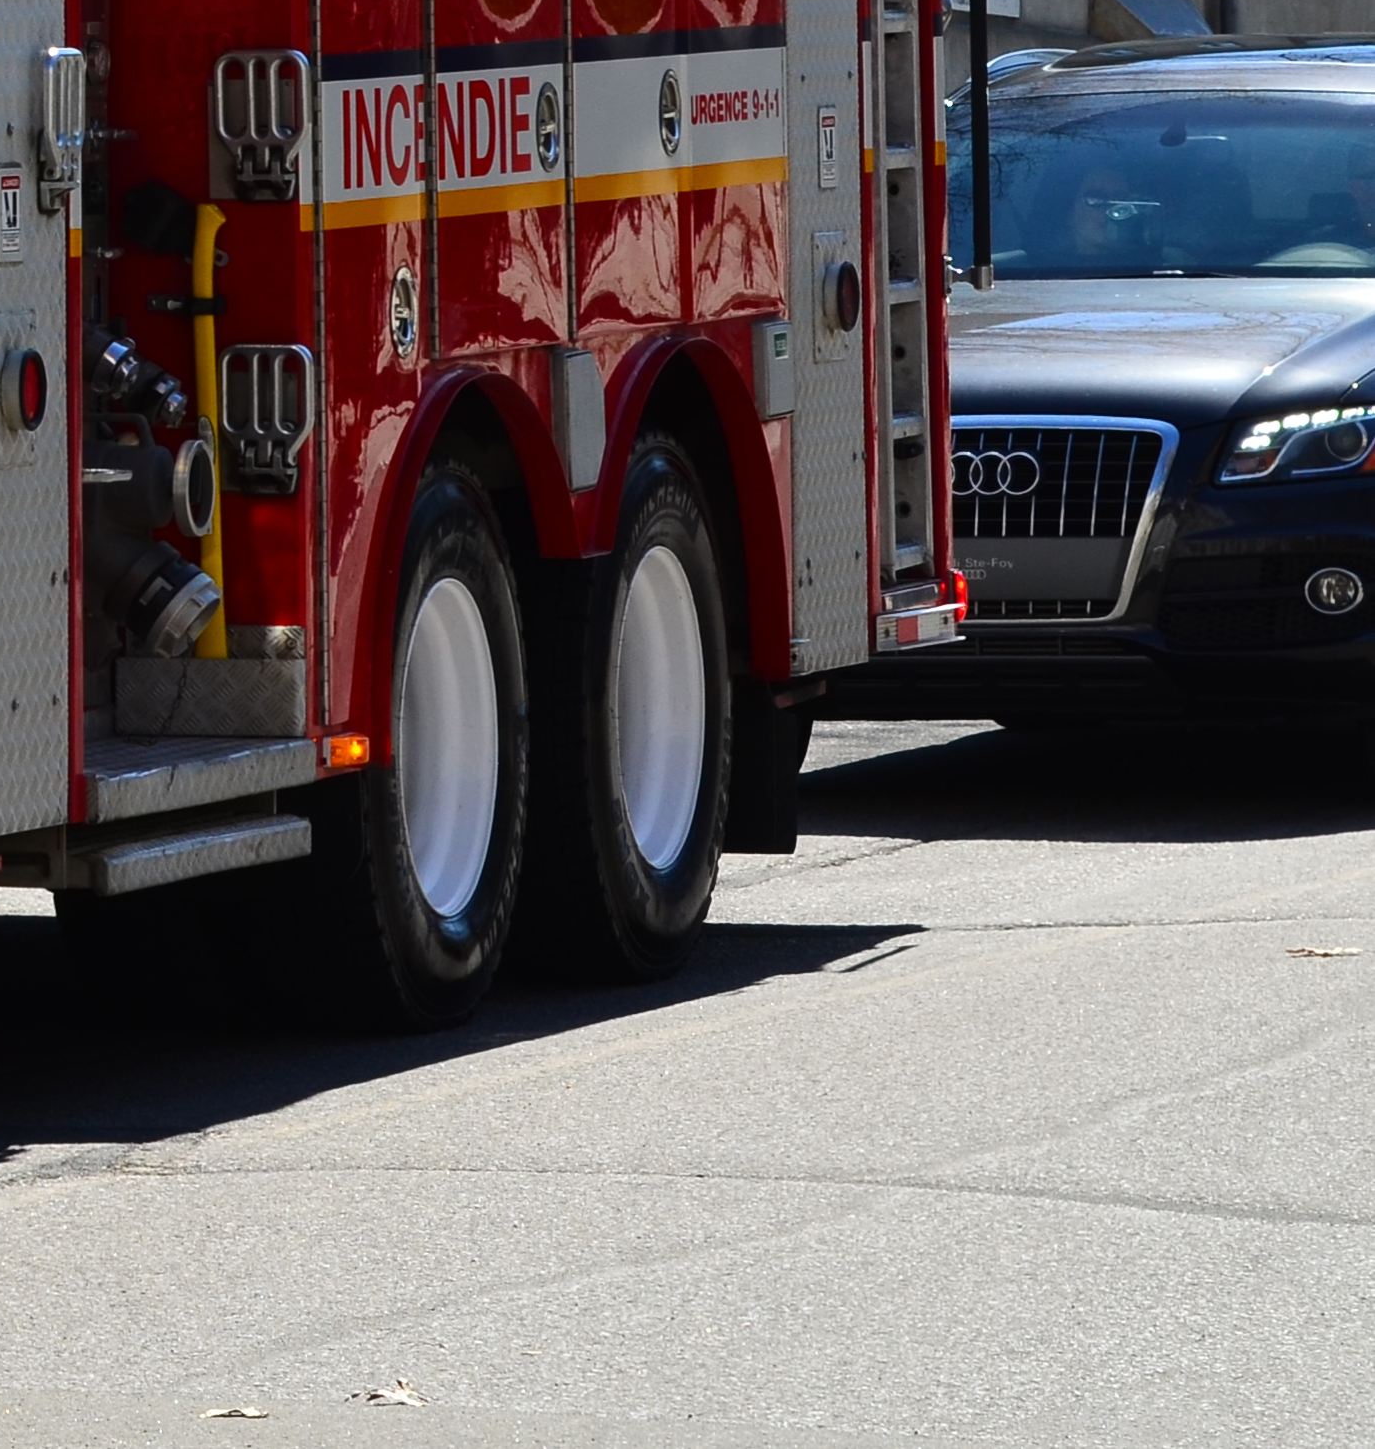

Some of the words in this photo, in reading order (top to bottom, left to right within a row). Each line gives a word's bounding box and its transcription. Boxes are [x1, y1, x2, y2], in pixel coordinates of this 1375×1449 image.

[690, 90, 749, 125] URGENCE
[753, 88, 780, 120] 9-1-1
[342, 76, 532, 190] INCENDIE
[965, 557, 1014, 569] Ste-Foy
